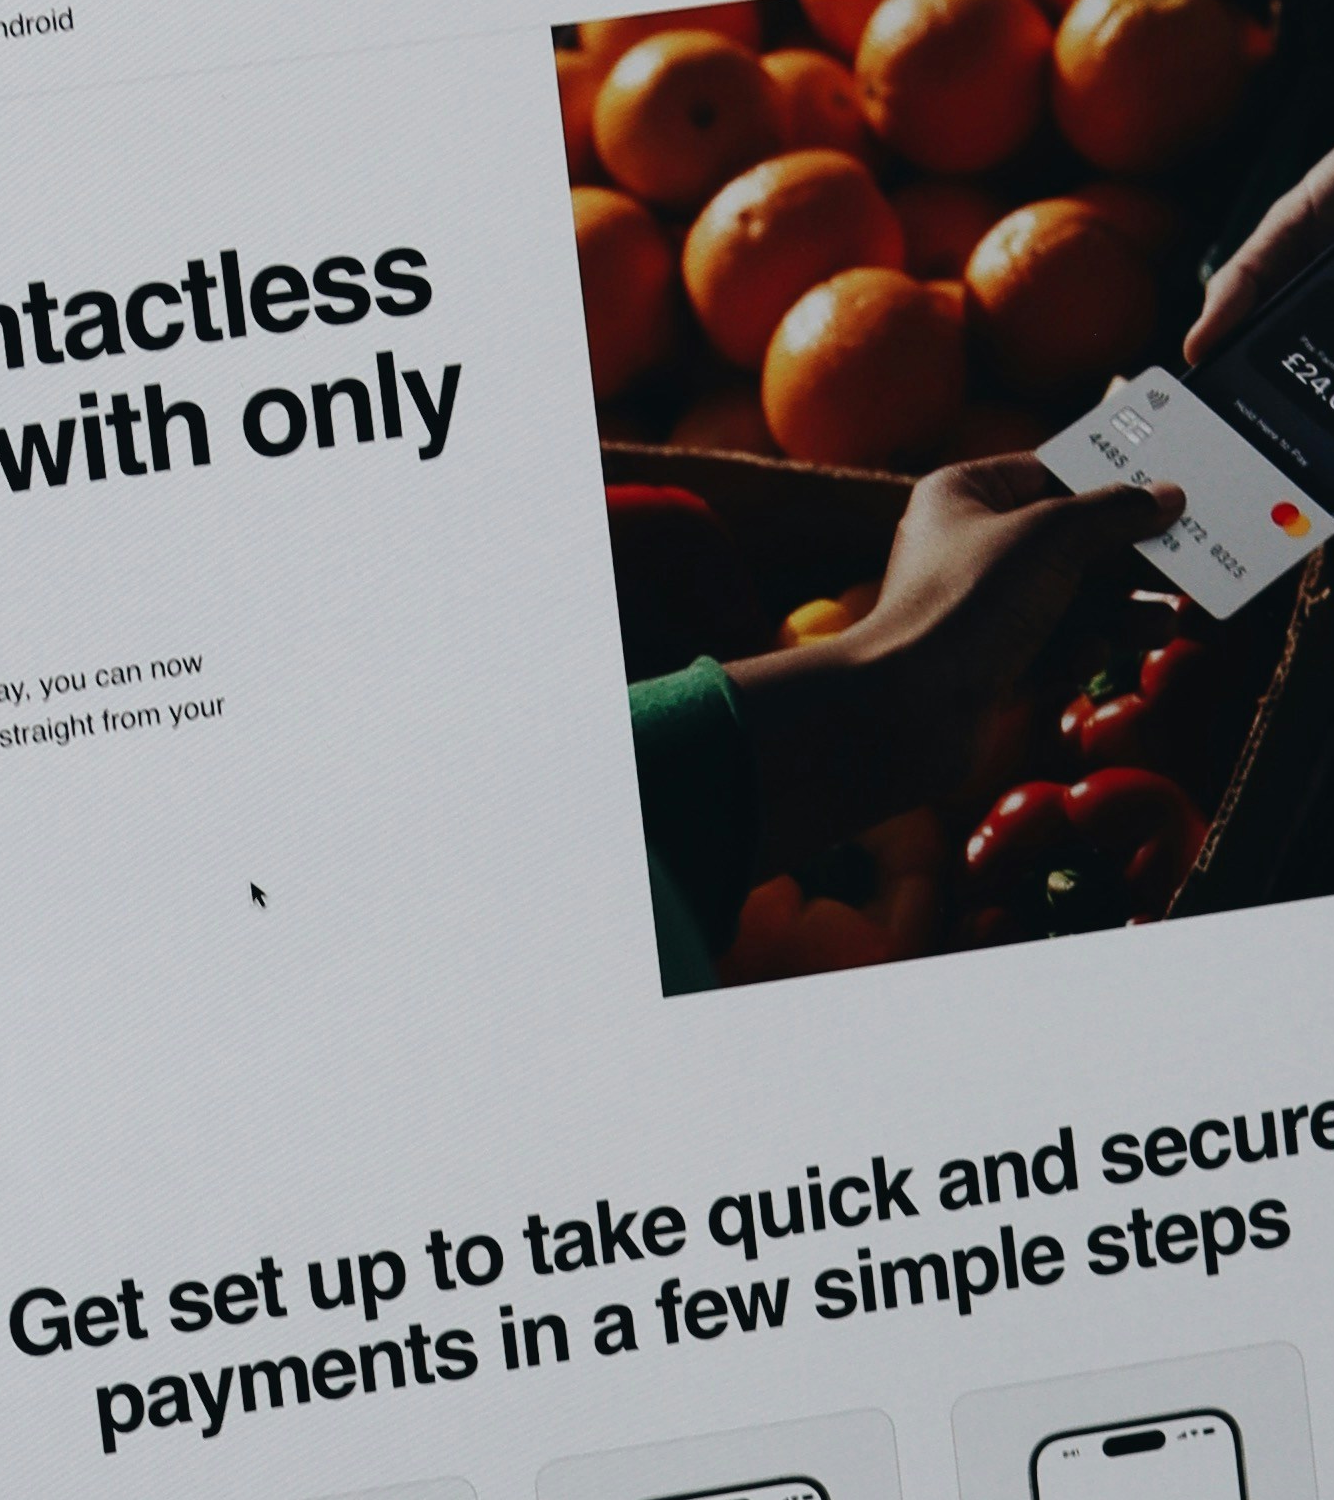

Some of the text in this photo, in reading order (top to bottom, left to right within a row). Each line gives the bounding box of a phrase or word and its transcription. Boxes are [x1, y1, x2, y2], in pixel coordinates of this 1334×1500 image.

[243, 351, 461, 461] only
[1088, 431, 1129, 469] 4485
[40, 673, 86, 700] you
[96, 665, 141, 686] can
[151, 656, 202, 678] now
[0, 714, 94, 747] straight
[103, 708, 160, 731] from
[169, 699, 223, 726] your
[10, 1279, 148, 1356] Get
[169, 1257, 287, 1332] set
[308, 1251, 406, 1321] up
[426, 1230, 503, 1290] to
[523, 1200, 686, 1275] take
[709, 1156, 919, 1261] quick
[939, 1127, 1078, 1211] and
[97, 1199, 1290, 1454] payments in a few simple steps
